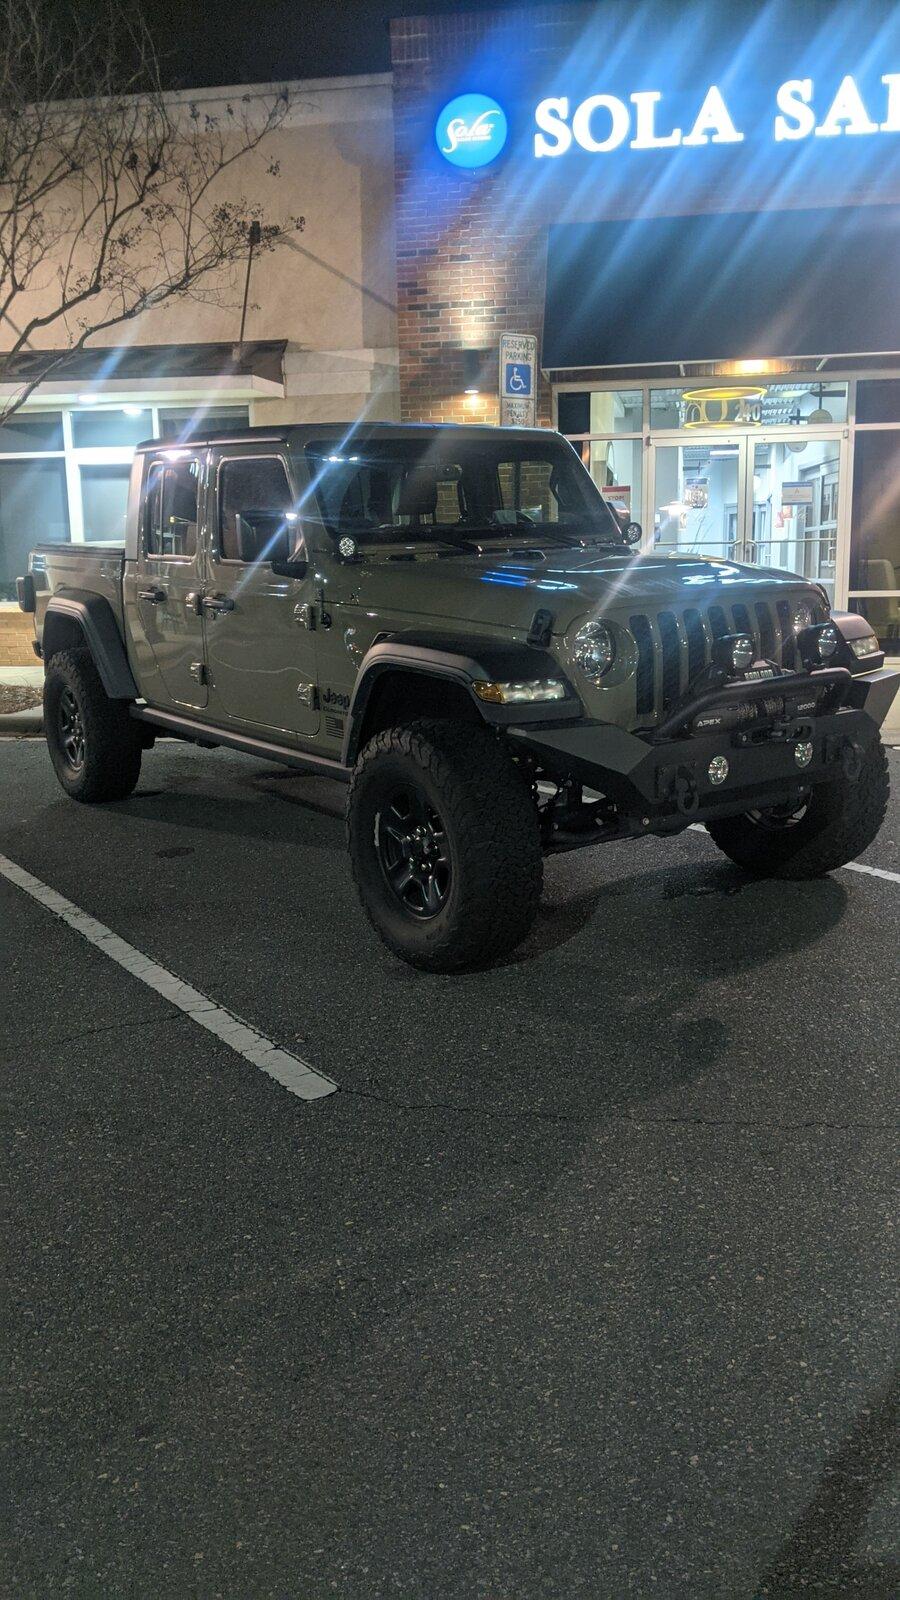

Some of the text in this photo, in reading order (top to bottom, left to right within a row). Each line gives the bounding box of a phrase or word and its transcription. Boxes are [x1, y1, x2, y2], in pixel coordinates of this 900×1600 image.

[534, 85, 744, 159] SOLA
[442, 109, 500, 153] Sola
[502, 339, 535, 351] RESERVED
[505, 351, 532, 361] PARKING
[734, 402, 760, 421] 240
[322, 688, 350, 710] Jeep
[797, 702, 816, 711] 12000
[697, 718, 721, 727] APEX
